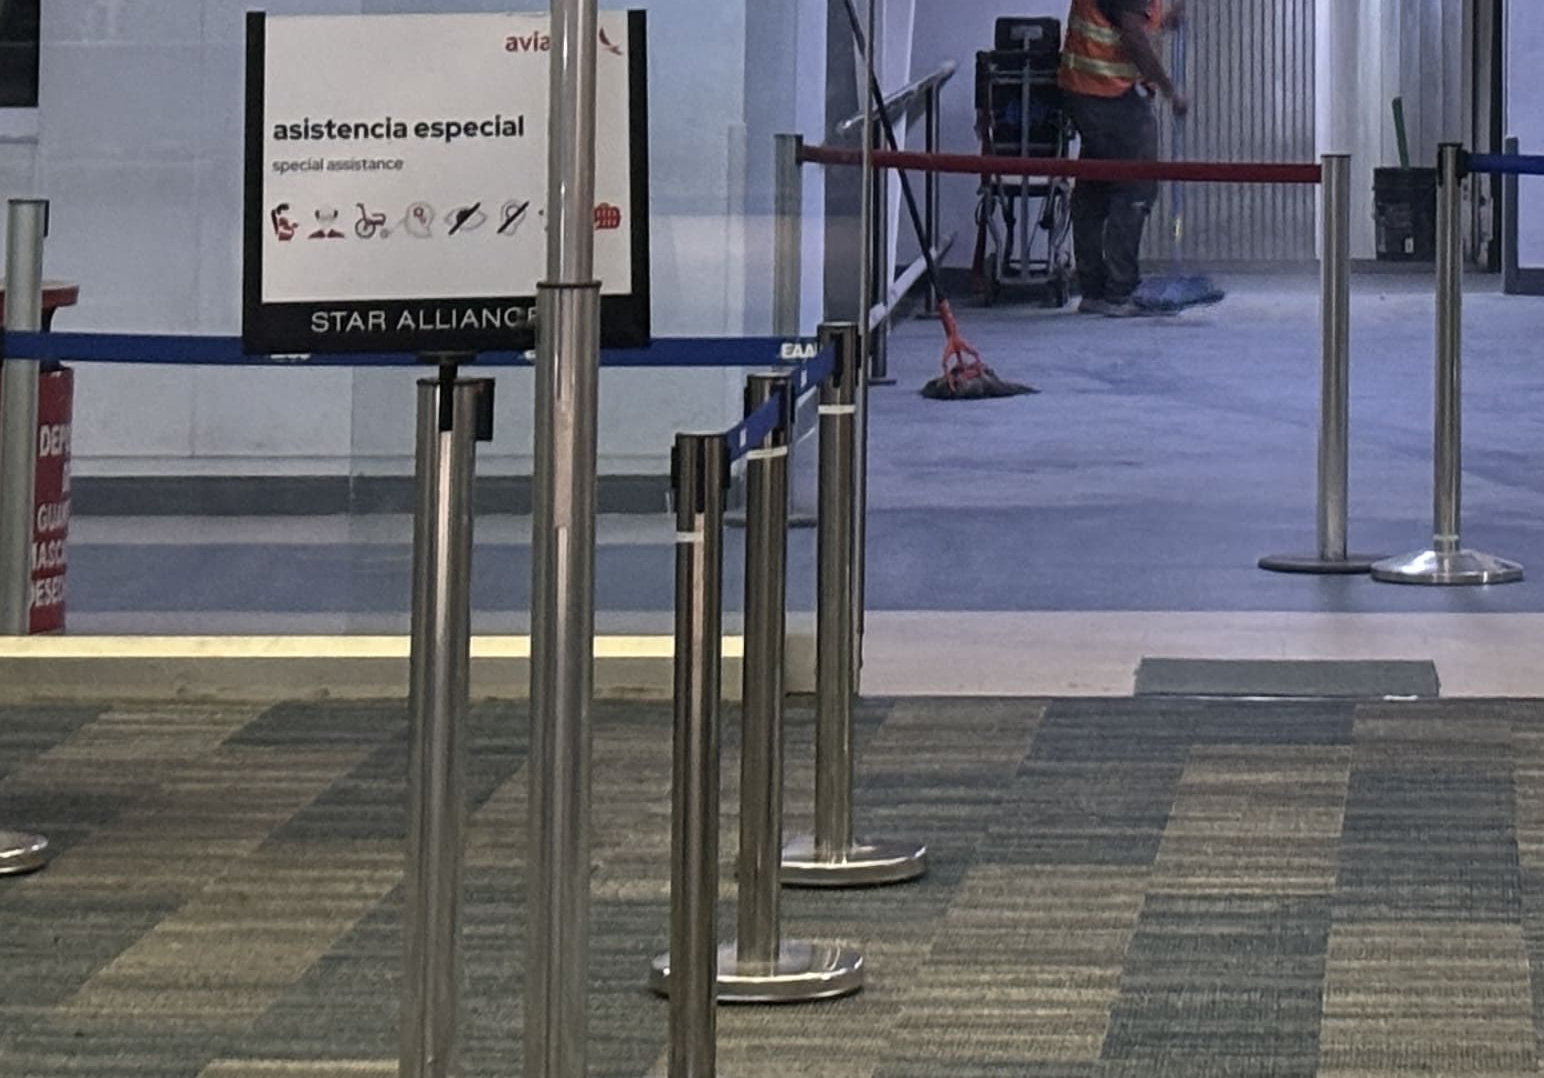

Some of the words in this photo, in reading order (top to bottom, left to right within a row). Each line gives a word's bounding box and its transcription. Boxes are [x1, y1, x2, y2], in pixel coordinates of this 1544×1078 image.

[505, 31, 550, 53] avia
[273, 116, 408, 141] asistencia
[414, 115, 525, 143] especial
[272, 158, 324, 174] special
[327, 157, 404, 172] assistance
[310, 310, 386, 335] STAR
